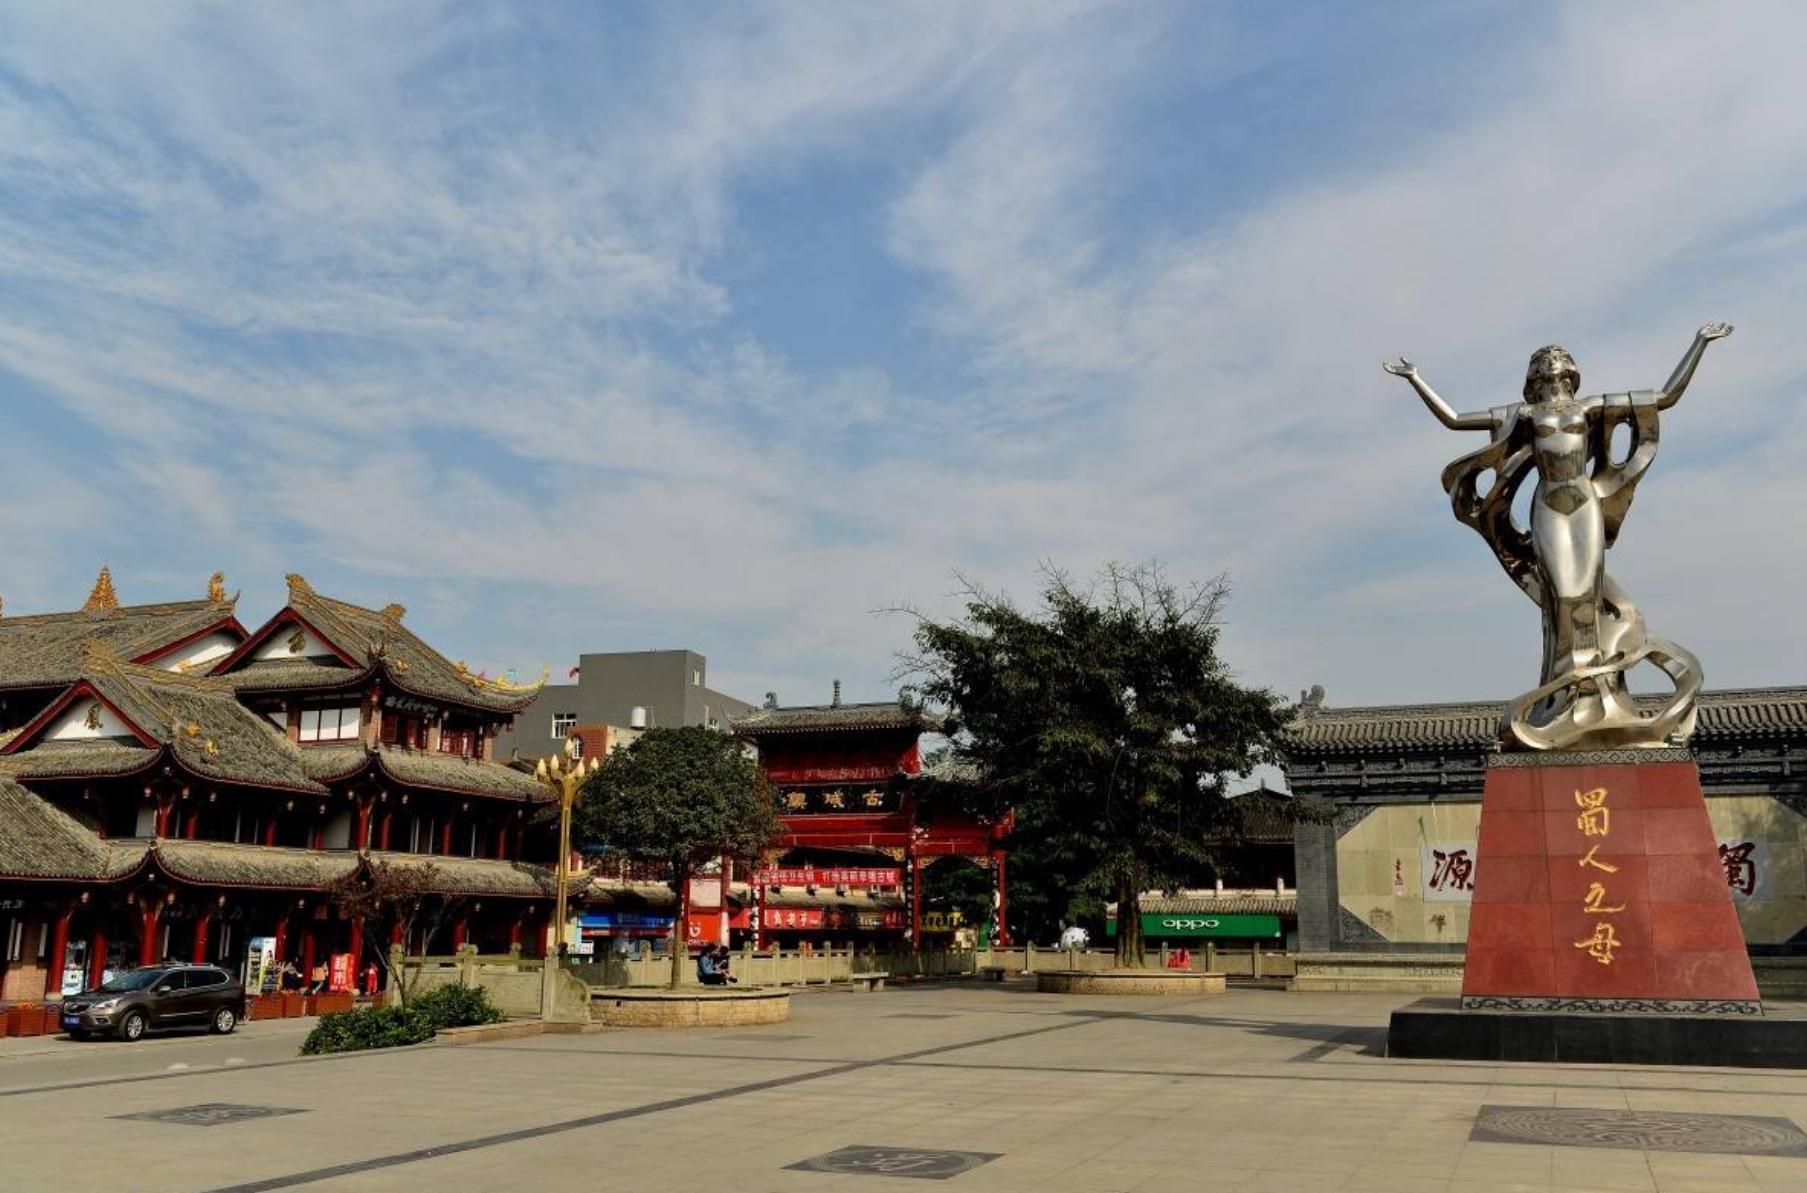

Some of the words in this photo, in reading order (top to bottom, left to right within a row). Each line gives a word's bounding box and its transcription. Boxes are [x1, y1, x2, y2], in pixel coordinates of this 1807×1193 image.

[1428, 849, 1474, 892] 源
[1573, 787, 1626, 965] 蜀人之母
